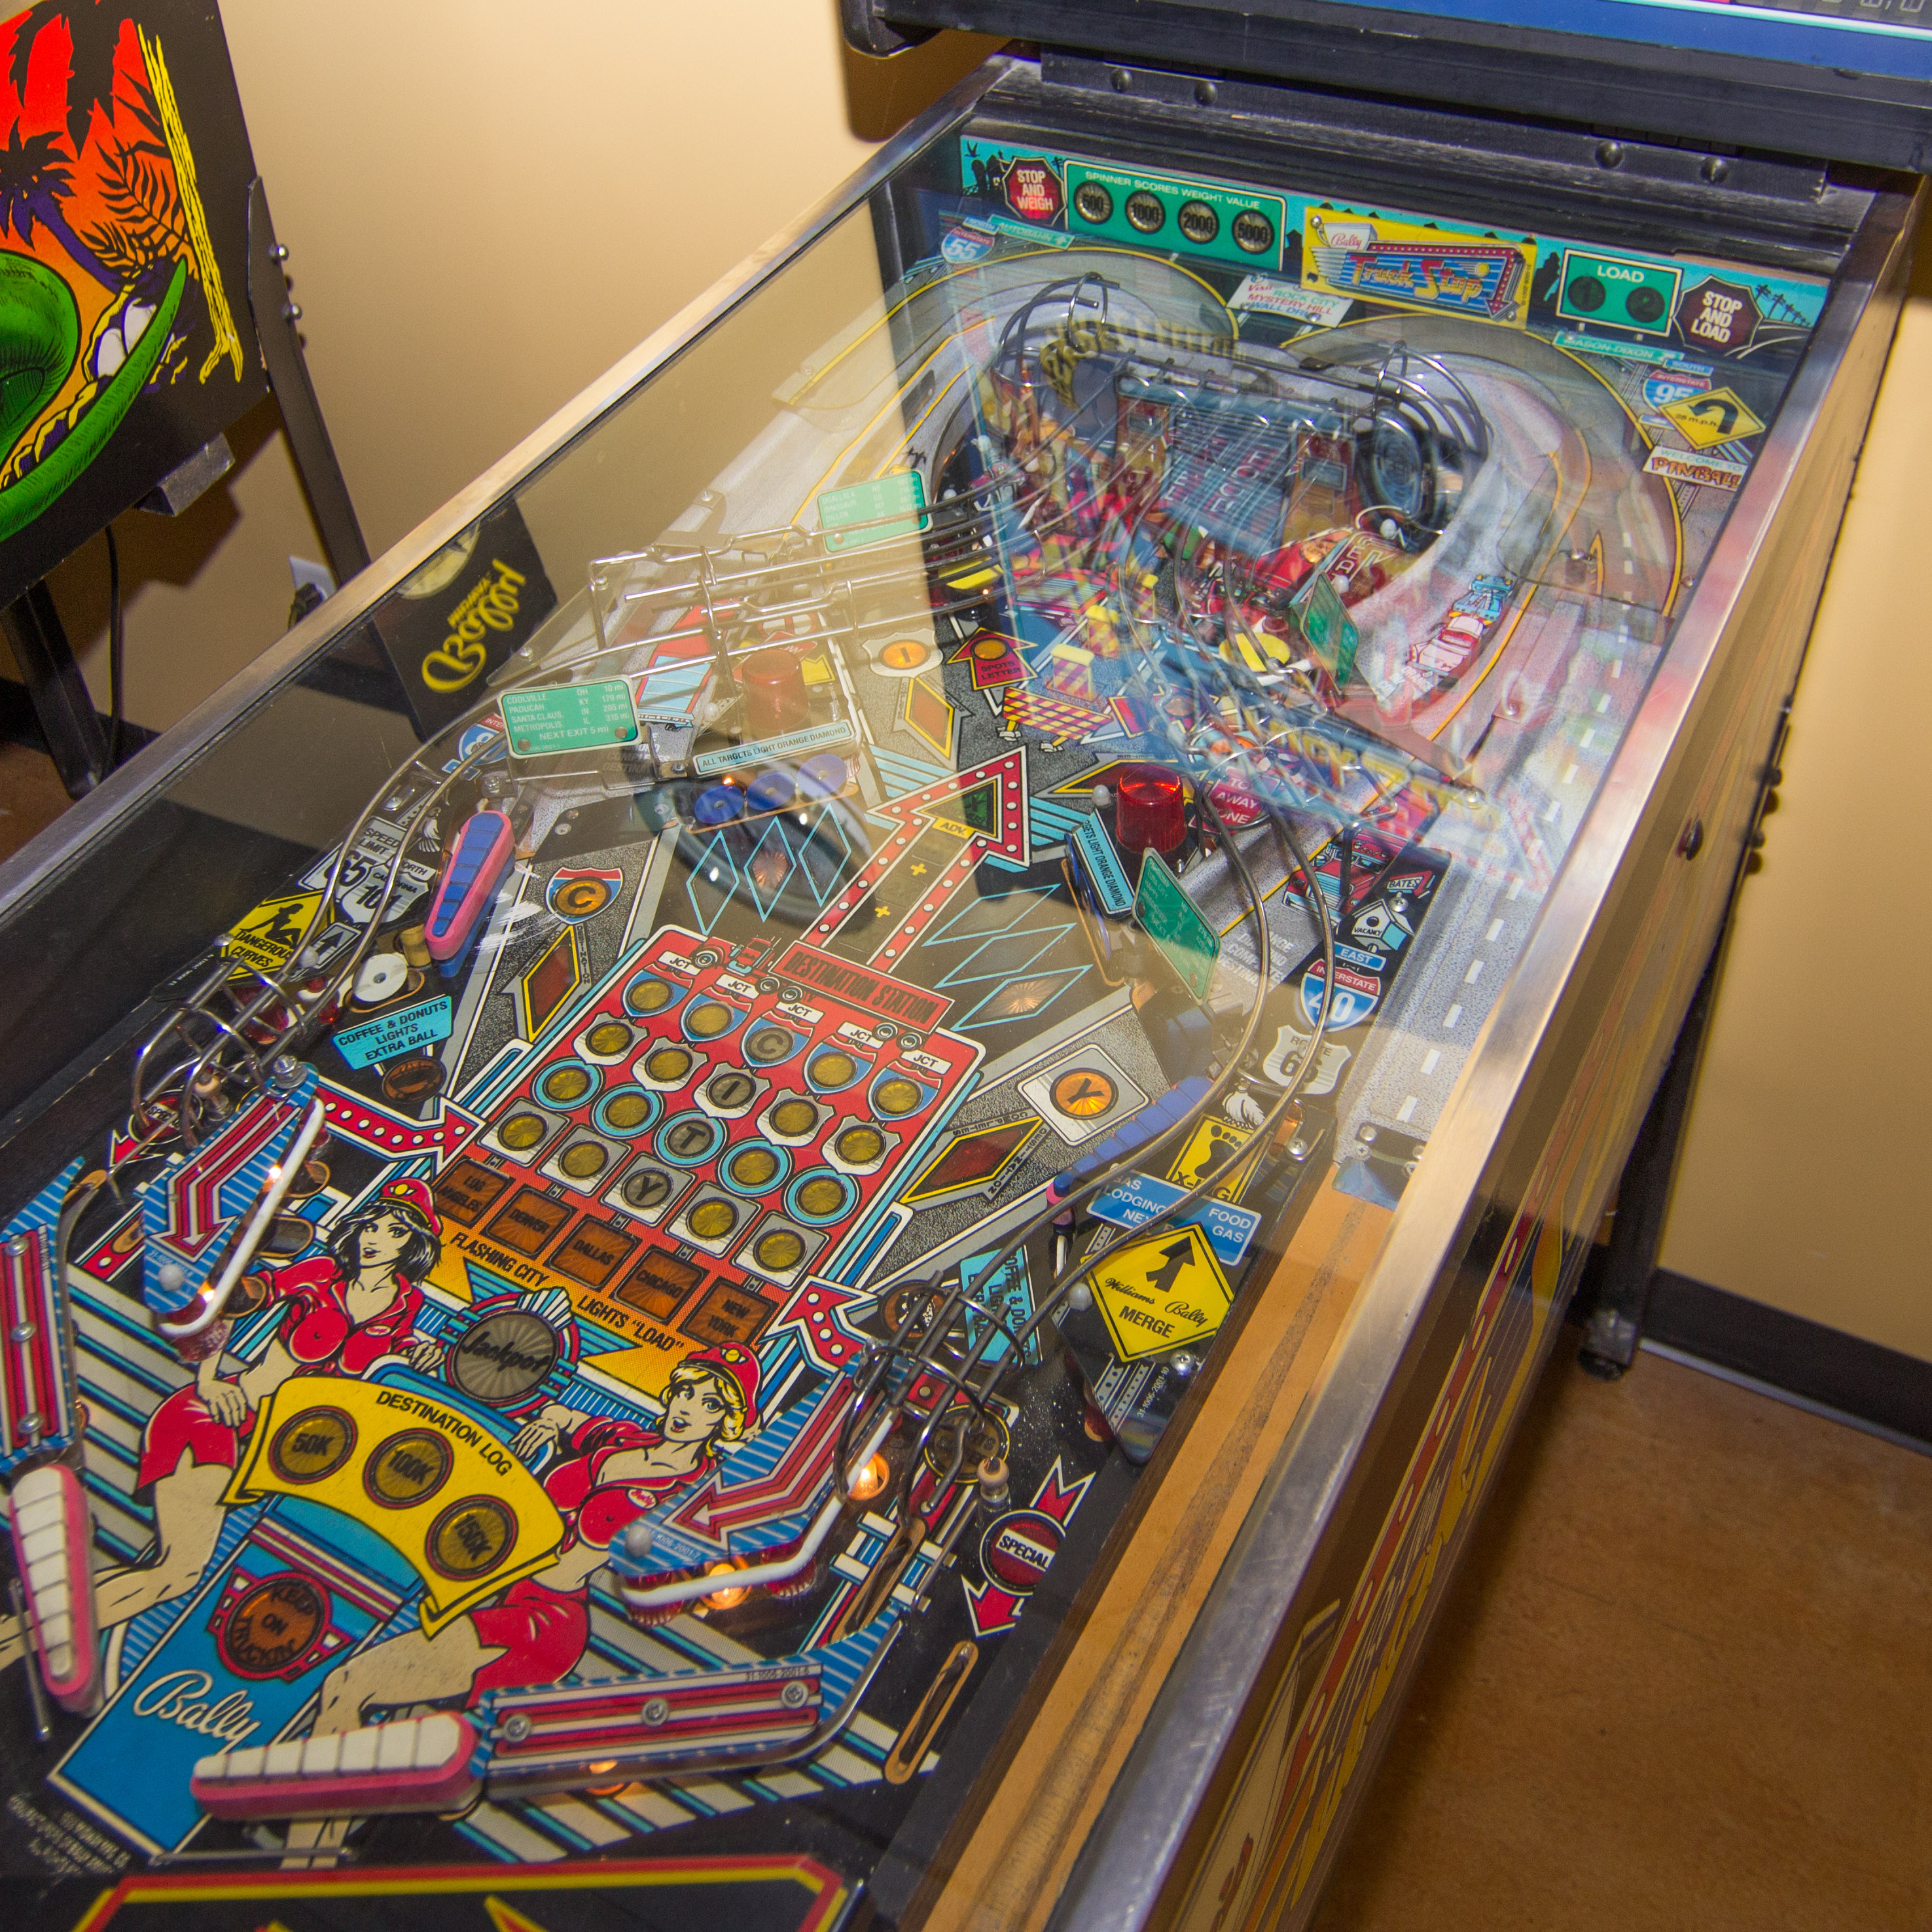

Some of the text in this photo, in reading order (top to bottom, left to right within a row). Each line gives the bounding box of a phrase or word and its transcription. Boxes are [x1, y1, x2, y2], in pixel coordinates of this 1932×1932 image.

[1017, 170, 1045, 183] STOP
[1022, 183, 1045, 196] AND
[1086, 171, 1260, 209] SPINNER SCORES WEIGHT VALUE
[1017, 196, 1053, 210] WEIGH
[1084, 196, 1103, 212] 500
[1131, 203, 1159, 221] 1000
[998, 223, 1052, 241] AUTOBAHN
[1183, 213, 1213, 230] 2000
[1238, 223, 1268, 241] 5000
[956, 229, 991, 245] INTERSTATE
[1331, 233, 1363, 250] Bally
[948, 239, 980, 258] 55
[1349, 255, 1414, 287] Truck
[1414, 259, 1484, 304] Stop
[1598, 265, 1644, 283] LOAD
[1247, 293, 1333, 315] MYSTERY HILL
[1251, 300, 1314, 319] WALL DRU
[1273, 290, 1340, 308] ROCK CITY
[1703, 291, 1742, 313] STOP
[1700, 308, 1732, 327] AND
[1691, 319, 1731, 343] LOAD
[1564, 337, 1655, 358] MASON-DIXON
[1658, 375, 1704, 386] INTERSTATE
[1661, 449, 1721, 467] WELCOME
[1651, 457, 1743, 488] PINBALL
[980, 668, 1022, 680] LETTER
[982, 661, 1014, 672] SPOTS
[485, 718, 504, 729] INTER
[511, 713, 535, 724] SANTA
[539, 730, 564, 741] NEXT
[567, 728, 588, 738] EXIT
[702, 726, 846, 767] ALL TARGETS LIGHT ORANGE DIAMOND
[1216, 792, 1258, 809] AWAY
[1217, 808, 1251, 824] ONE
[364, 828, 401, 848] SPEED
[941, 822, 965, 836] ADV.
[359, 838, 389, 855] LIMIT
[399, 859, 428, 876] ORTH
[1090, 837, 1127, 906] LIGHT ORANGE DIAMOND
[1388, 879, 1421, 888] BATES
[567, 885, 596, 908] C
[1353, 927, 1383, 936] VACANCY
[234, 931, 295, 960] DANGEROU
[231, 946, 273, 967] CURVES
[669, 956, 694, 972] JCT
[1340, 949, 1374, 965] EAST
[726, 980, 753, 993] JCT
[782, 950, 939, 1024] DESTINATION STATION
[1316, 966, 1376, 992] INERSTATE
[788, 1004, 812, 1017] JCT
[338, 1001, 448, 1046] COFFEE & DONUTS
[375, 1023, 419, 1045] LIGHTS
[365, 1029, 438, 1061] EXTRA BALL
[759, 1033, 785, 1059] C
[850, 1029, 874, 1043] JCT
[1290, 1036, 1333, 1057] ROE
[912, 1054, 939, 1067] JCT
[1067, 1077, 1105, 1105] Y
[680, 1126, 707, 1149] T
[463, 1175, 486, 1192] LOS
[636, 1176, 662, 1202] Y
[439, 1185, 482, 1211] ANGELES
[509, 1208, 550, 1234] DENVER
[1209, 1208, 1251, 1229] FOOD
[1212, 1225, 1244, 1243] GAS
[573, 1239, 615, 1266] DALLAS
[450, 1232, 518, 1272] FLASHING
[514, 1264, 550, 1287] CITY
[577, 1295, 630, 1328] LIGHTS
[1005, 1253, 1022, 1293] OFFEE
[635, 1270, 683, 1298] CHICAGO
[721, 1298, 750, 1319] NEW
[1105, 1278, 1209, 1328] Williams Bally
[707, 1314, 740, 1338] YORK
[1118, 1305, 1175, 1338] MERGE
[461, 1331, 551, 1372] Jackpot
[1137, 1367, 1170, 1418] 31-1006-2001-10
[376, 1390, 512, 1477] DESTINATION LOG
[291, 1433, 334, 1457] 50K
[389, 1449, 435, 1486] 100K
[454, 1512, 494, 1561] 150K
[999, 1535, 1050, 1567] SPECIAL
[261, 1613, 289, 1636] ON
[133, 1669, 262, 1744] Bally
